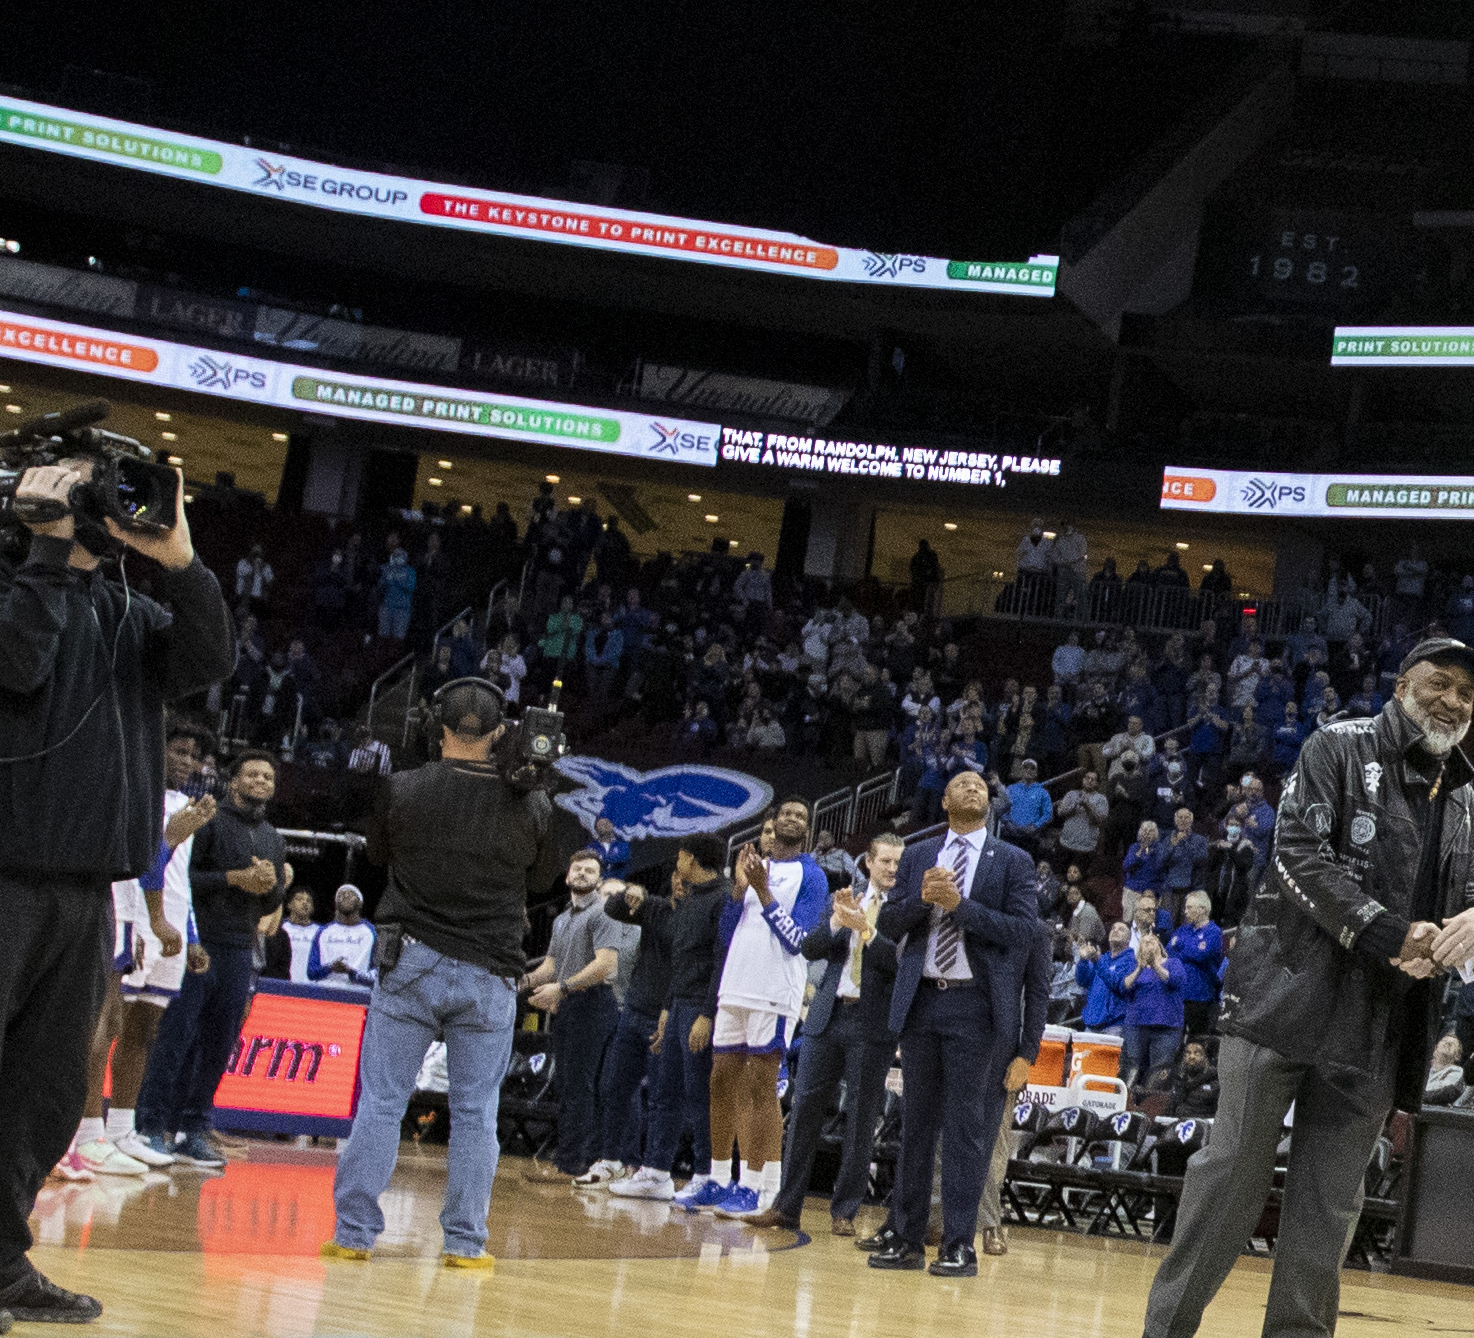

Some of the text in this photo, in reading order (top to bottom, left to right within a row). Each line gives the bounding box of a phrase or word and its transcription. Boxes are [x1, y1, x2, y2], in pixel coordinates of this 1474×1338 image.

[8, 114, 76, 144] PRINT
[82, 130, 203, 168] SOLUTIONS
[443, 198, 480, 218] THE
[487, 206, 590, 233] KEYSTONE
[598, 221, 624, 237] TO
[631, 226, 690, 247] PRINT
[695, 235, 818, 265] EXCELLENCE
[967, 264, 1054, 283] MANAGED
[1250, 255, 1359, 288] 1982
[1336, 341, 1385, 354] PRINT
[316, 383, 415, 412] MANAGED
[422, 398, 485, 422] PRINT
[490, 407, 604, 438] SOLUTIONS
[722, 444, 761, 464] GIVE
[762, 449, 775, 466] A
[776, 450, 825, 471] WARM
[827, 456, 904, 477] WELCOME
[905, 463, 926, 480] TO
[928, 465, 992, 485] NUMBER
[766, 433, 813, 453] FROM
[903, 447, 938, 465] NEW
[938, 450, 998, 472] JERSEY,
[1001, 455, 1062, 475] PLEASE
[1346, 489, 1431, 504] MANAGED
